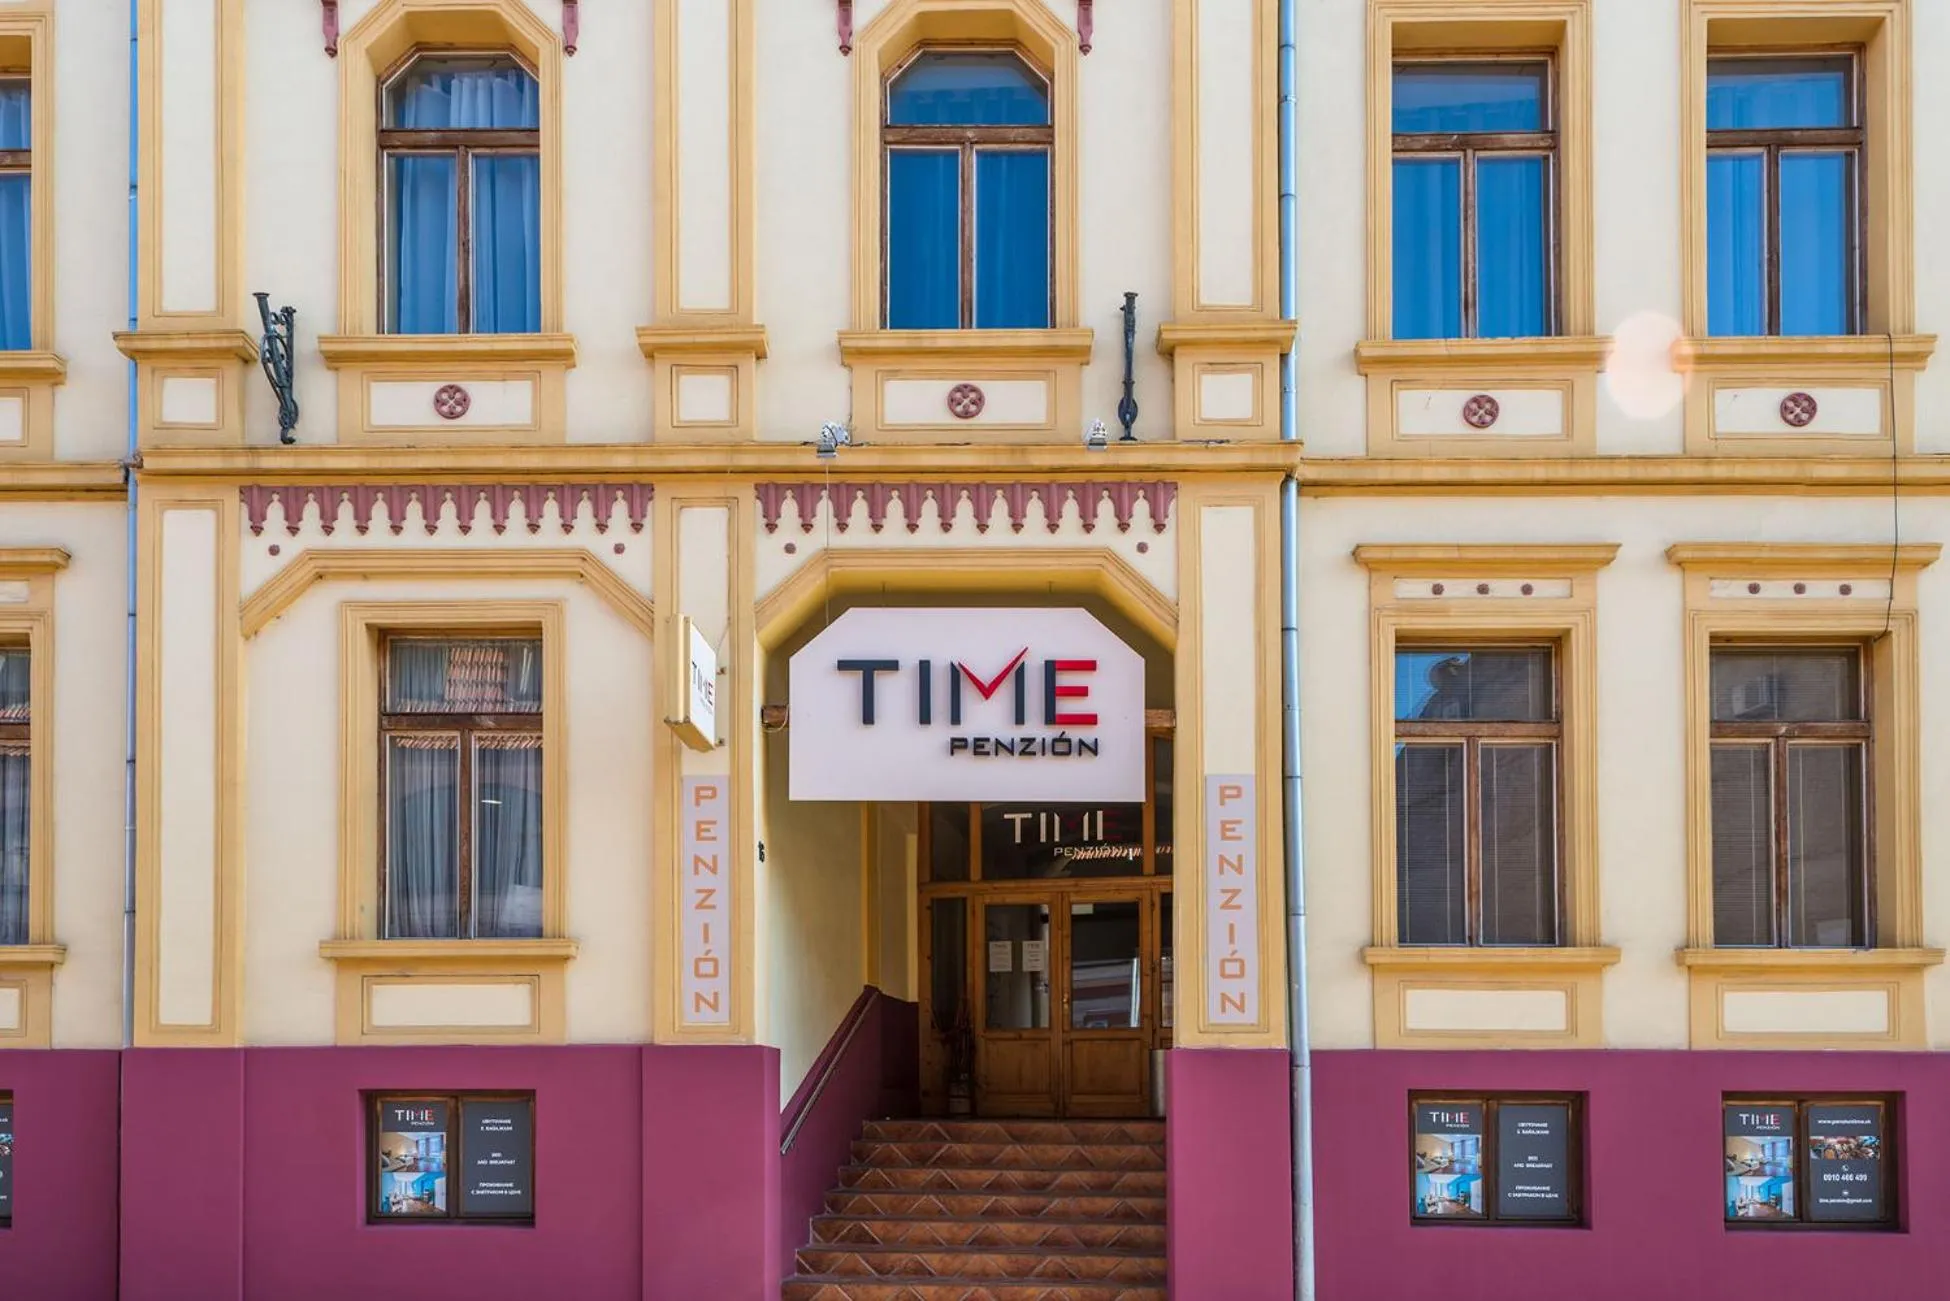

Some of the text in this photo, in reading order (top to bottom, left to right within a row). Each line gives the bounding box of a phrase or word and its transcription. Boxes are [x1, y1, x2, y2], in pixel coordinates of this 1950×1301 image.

[837, 647, 1098, 725] TIME
[950, 731, 1098, 757] PENZIÓN
[1003, 810, 1122, 843] TIME
[693, 784, 720, 1014] PENZIÓN
[1218, 784, 1246, 1014] PENZIÓN
[394, 1109, 433, 1121] TIME
[1429, 1112, 1470, 1124] TIME
[1739, 1113, 1781, 1125] TIME
